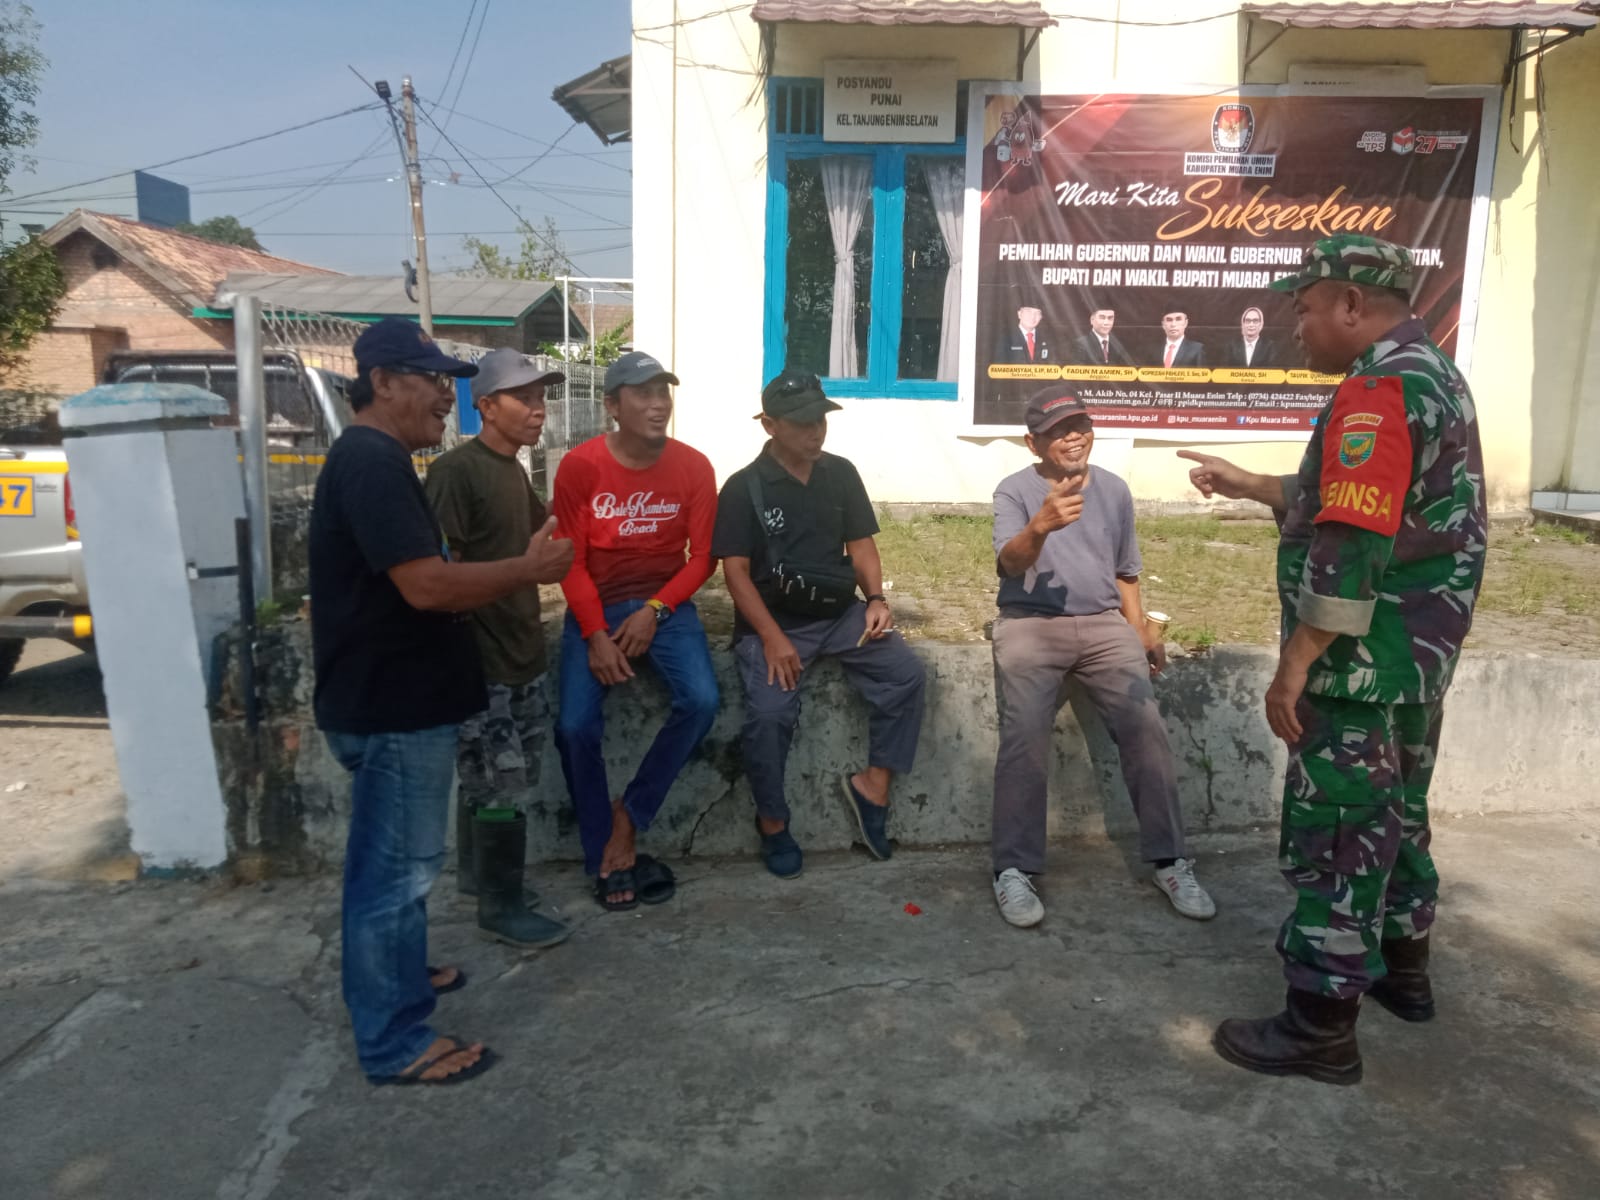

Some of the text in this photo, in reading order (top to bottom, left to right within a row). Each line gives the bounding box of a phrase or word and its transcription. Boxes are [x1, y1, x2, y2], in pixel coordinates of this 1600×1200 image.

[837, 77, 892, 89] POSYANDU
[870, 93, 902, 106] PUNAI
[1365, 142, 1384, 151] TPS
[1415, 136, 1438, 153] 27
[1187, 155, 1274, 165] KOMISI PEMILIHAN UMUM
[1186, 164, 1273, 175] KABUPATEN MUARA ENIM
[1055, 178, 1396, 240] Mari Kita Sukseskan
[999, 243, 1444, 268] PEMILIHAN GUBERNUR DAN WAKIL GUBERNUR TAN,
[1042, 268, 1089, 285] BUPATI
[1093, 268, 1121, 286] DAN
[1125, 269, 1169, 287] WAKIL
[1172, 270, 1219, 288] BUPATI
[1222, 271, 1270, 288] MUARA
[1096, 389, 1114, 397] Akib
[1155, 391, 1175, 399] Pasar
[1182, 391, 1205, 399] Muara
[1206, 392, 1225, 400] Enim
[1226, 393, 1243, 401] Telp
[1255, 400, 1275, 408] Email
[1281, 401, 1329, 409] kpumuaraen
[1246, 416, 1299, 424] Kpu Muara Enim
[1324, 481, 1392, 522] BINSA
[619, 520, 658, 536] Beach
